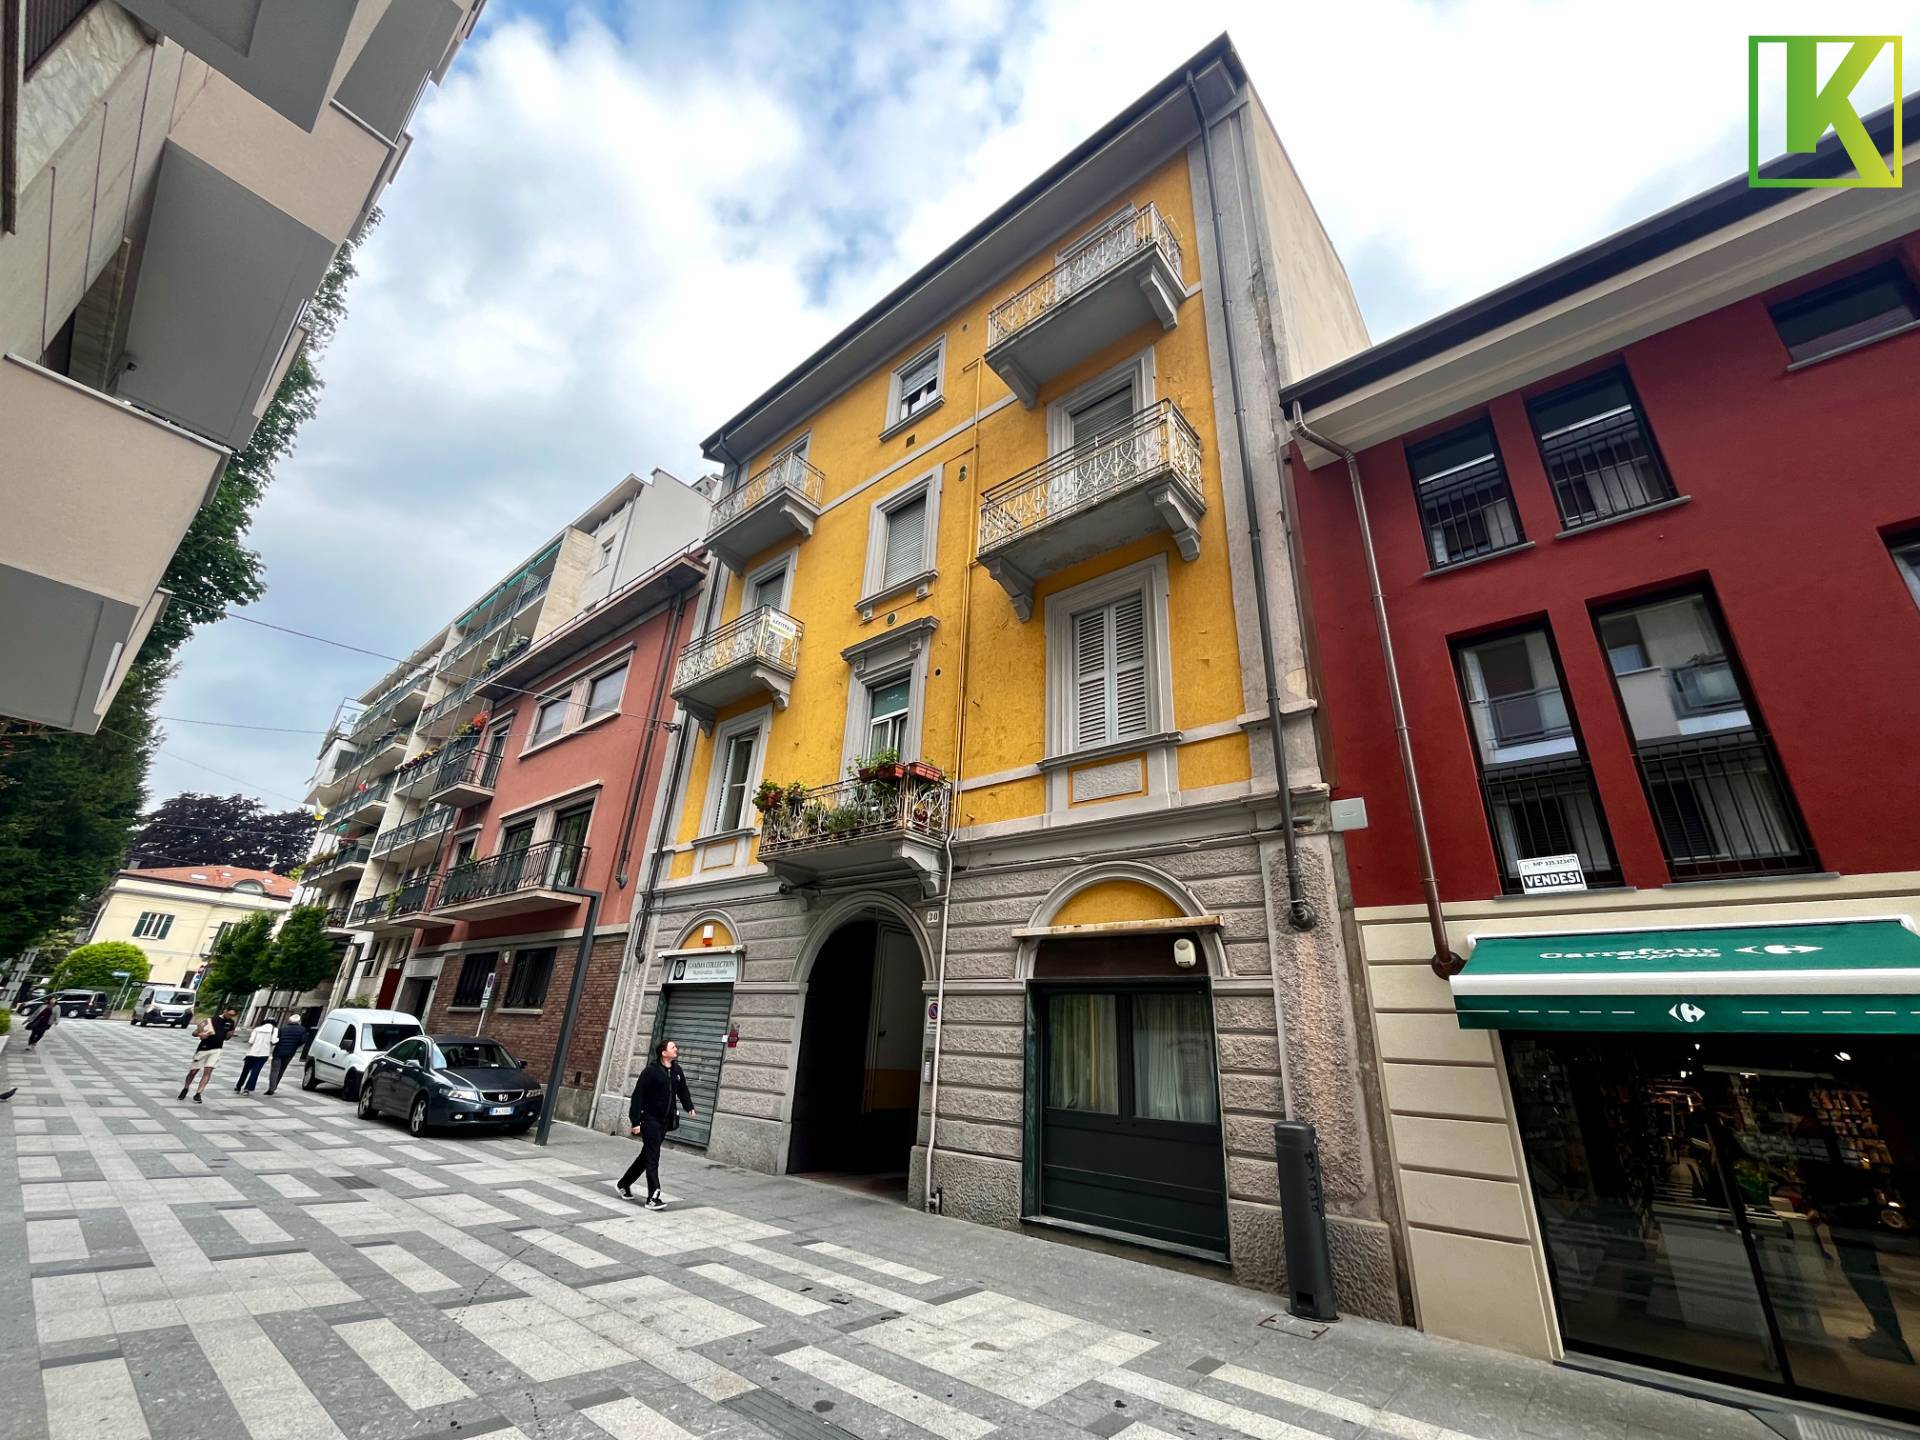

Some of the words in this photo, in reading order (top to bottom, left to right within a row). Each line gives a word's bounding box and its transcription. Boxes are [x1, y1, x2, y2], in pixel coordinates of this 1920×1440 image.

[1524, 872, 1581, 888] VENDESI
[928, 912, 938, 922] 30
[1539, 948, 1719, 959] Carrefour
